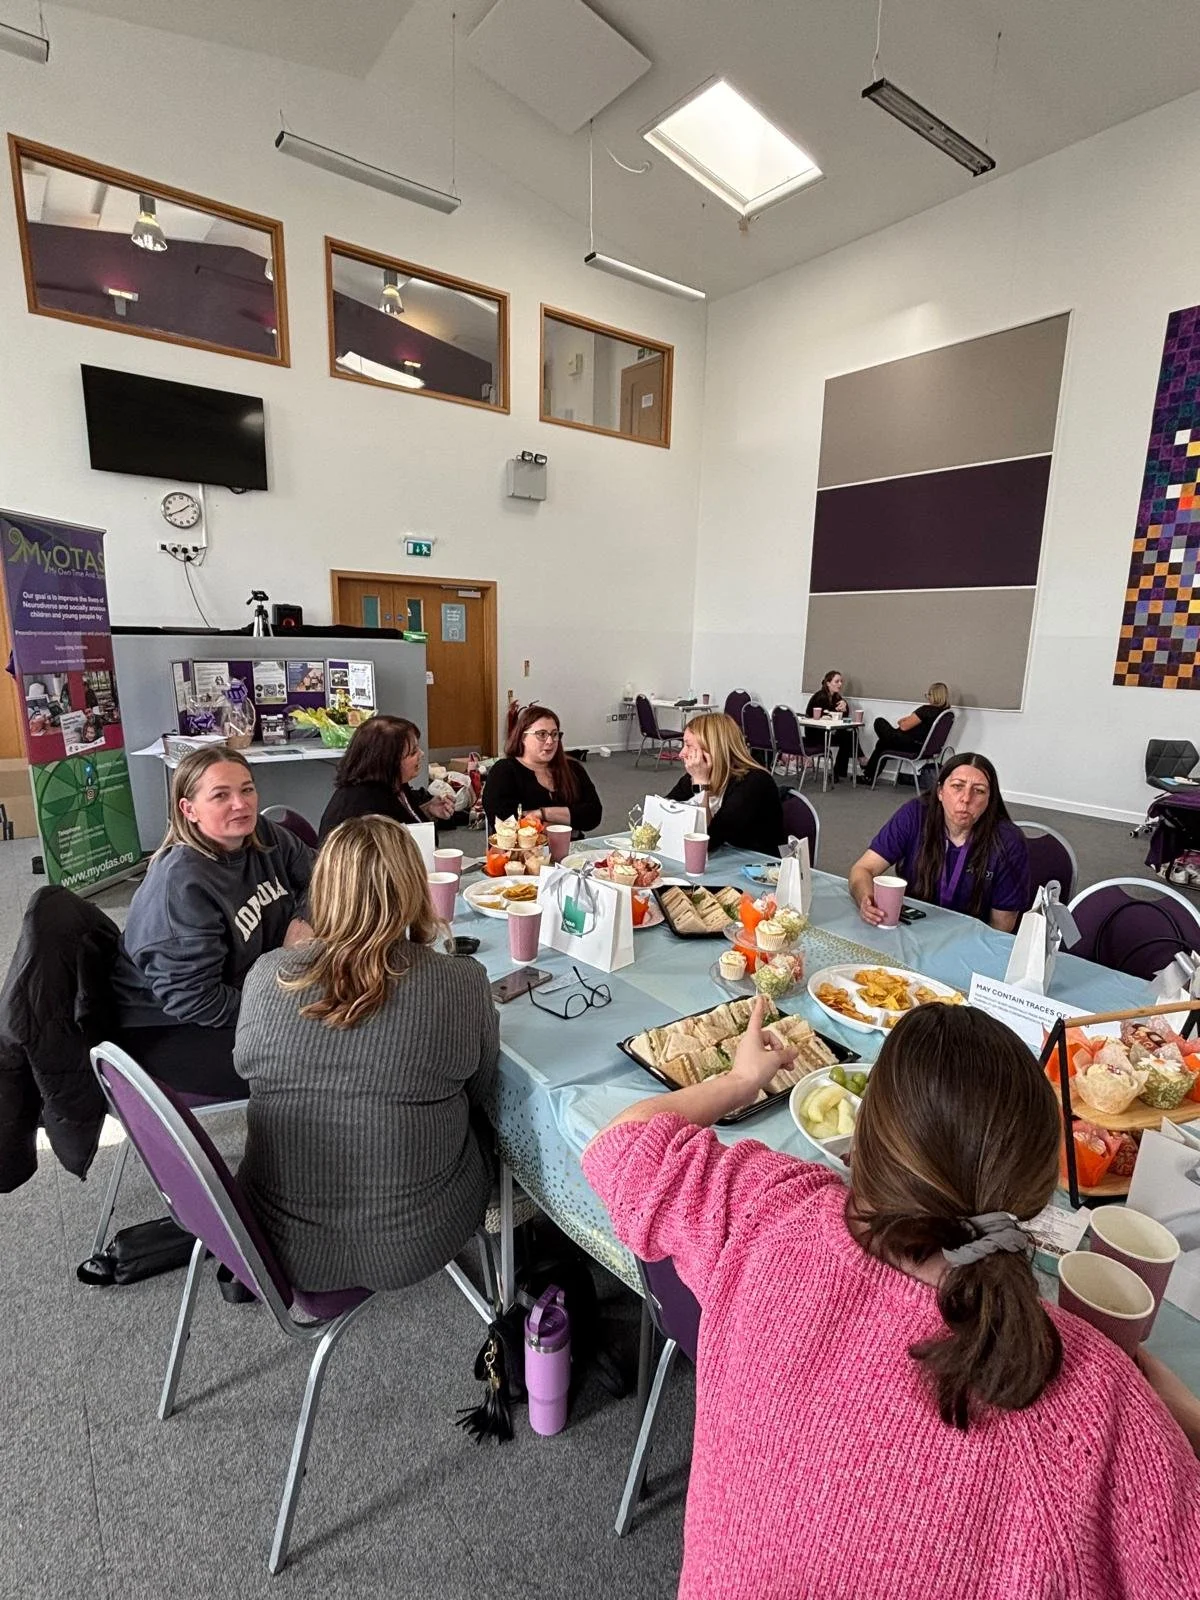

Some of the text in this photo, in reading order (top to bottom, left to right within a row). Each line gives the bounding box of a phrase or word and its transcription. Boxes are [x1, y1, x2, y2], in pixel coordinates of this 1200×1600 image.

[22, 591, 33, 599] Our
[35, 593, 46, 601] goal
[58, 594, 78, 602] improve
[22, 601, 58, 610] Neurodiverse
[62, 613, 78, 621] young
[61, 851, 134, 888] www.myotas.org
[976, 983, 991, 993] MAY
[992, 988, 1025, 1006] CONTAIN
[1026, 1000, 1055, 1016] TRACES
